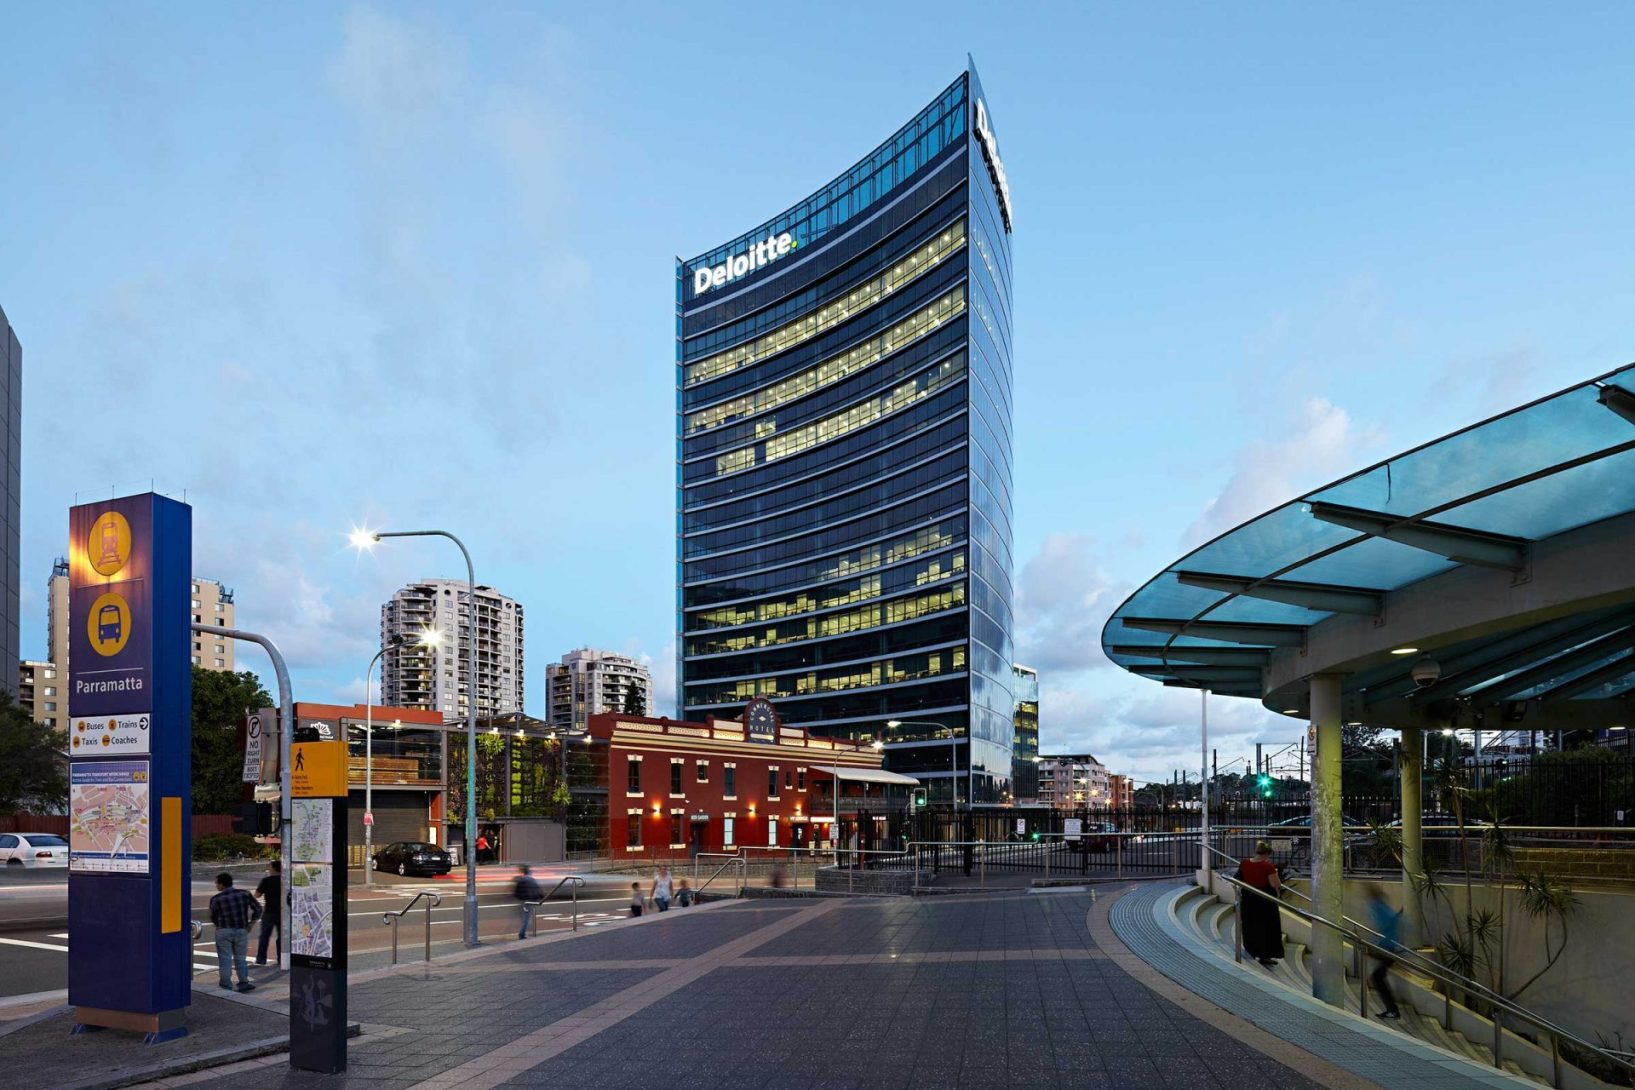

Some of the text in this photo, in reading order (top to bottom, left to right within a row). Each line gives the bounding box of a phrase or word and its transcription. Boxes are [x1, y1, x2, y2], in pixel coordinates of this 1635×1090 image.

[76, 677, 143, 694] Parramatta
[86, 720, 138, 731] Buses Trains
[750, 725, 775, 734] HOTEL
[82, 736, 138, 746] Taxis Coaches
[249, 740, 259, 749] NO
